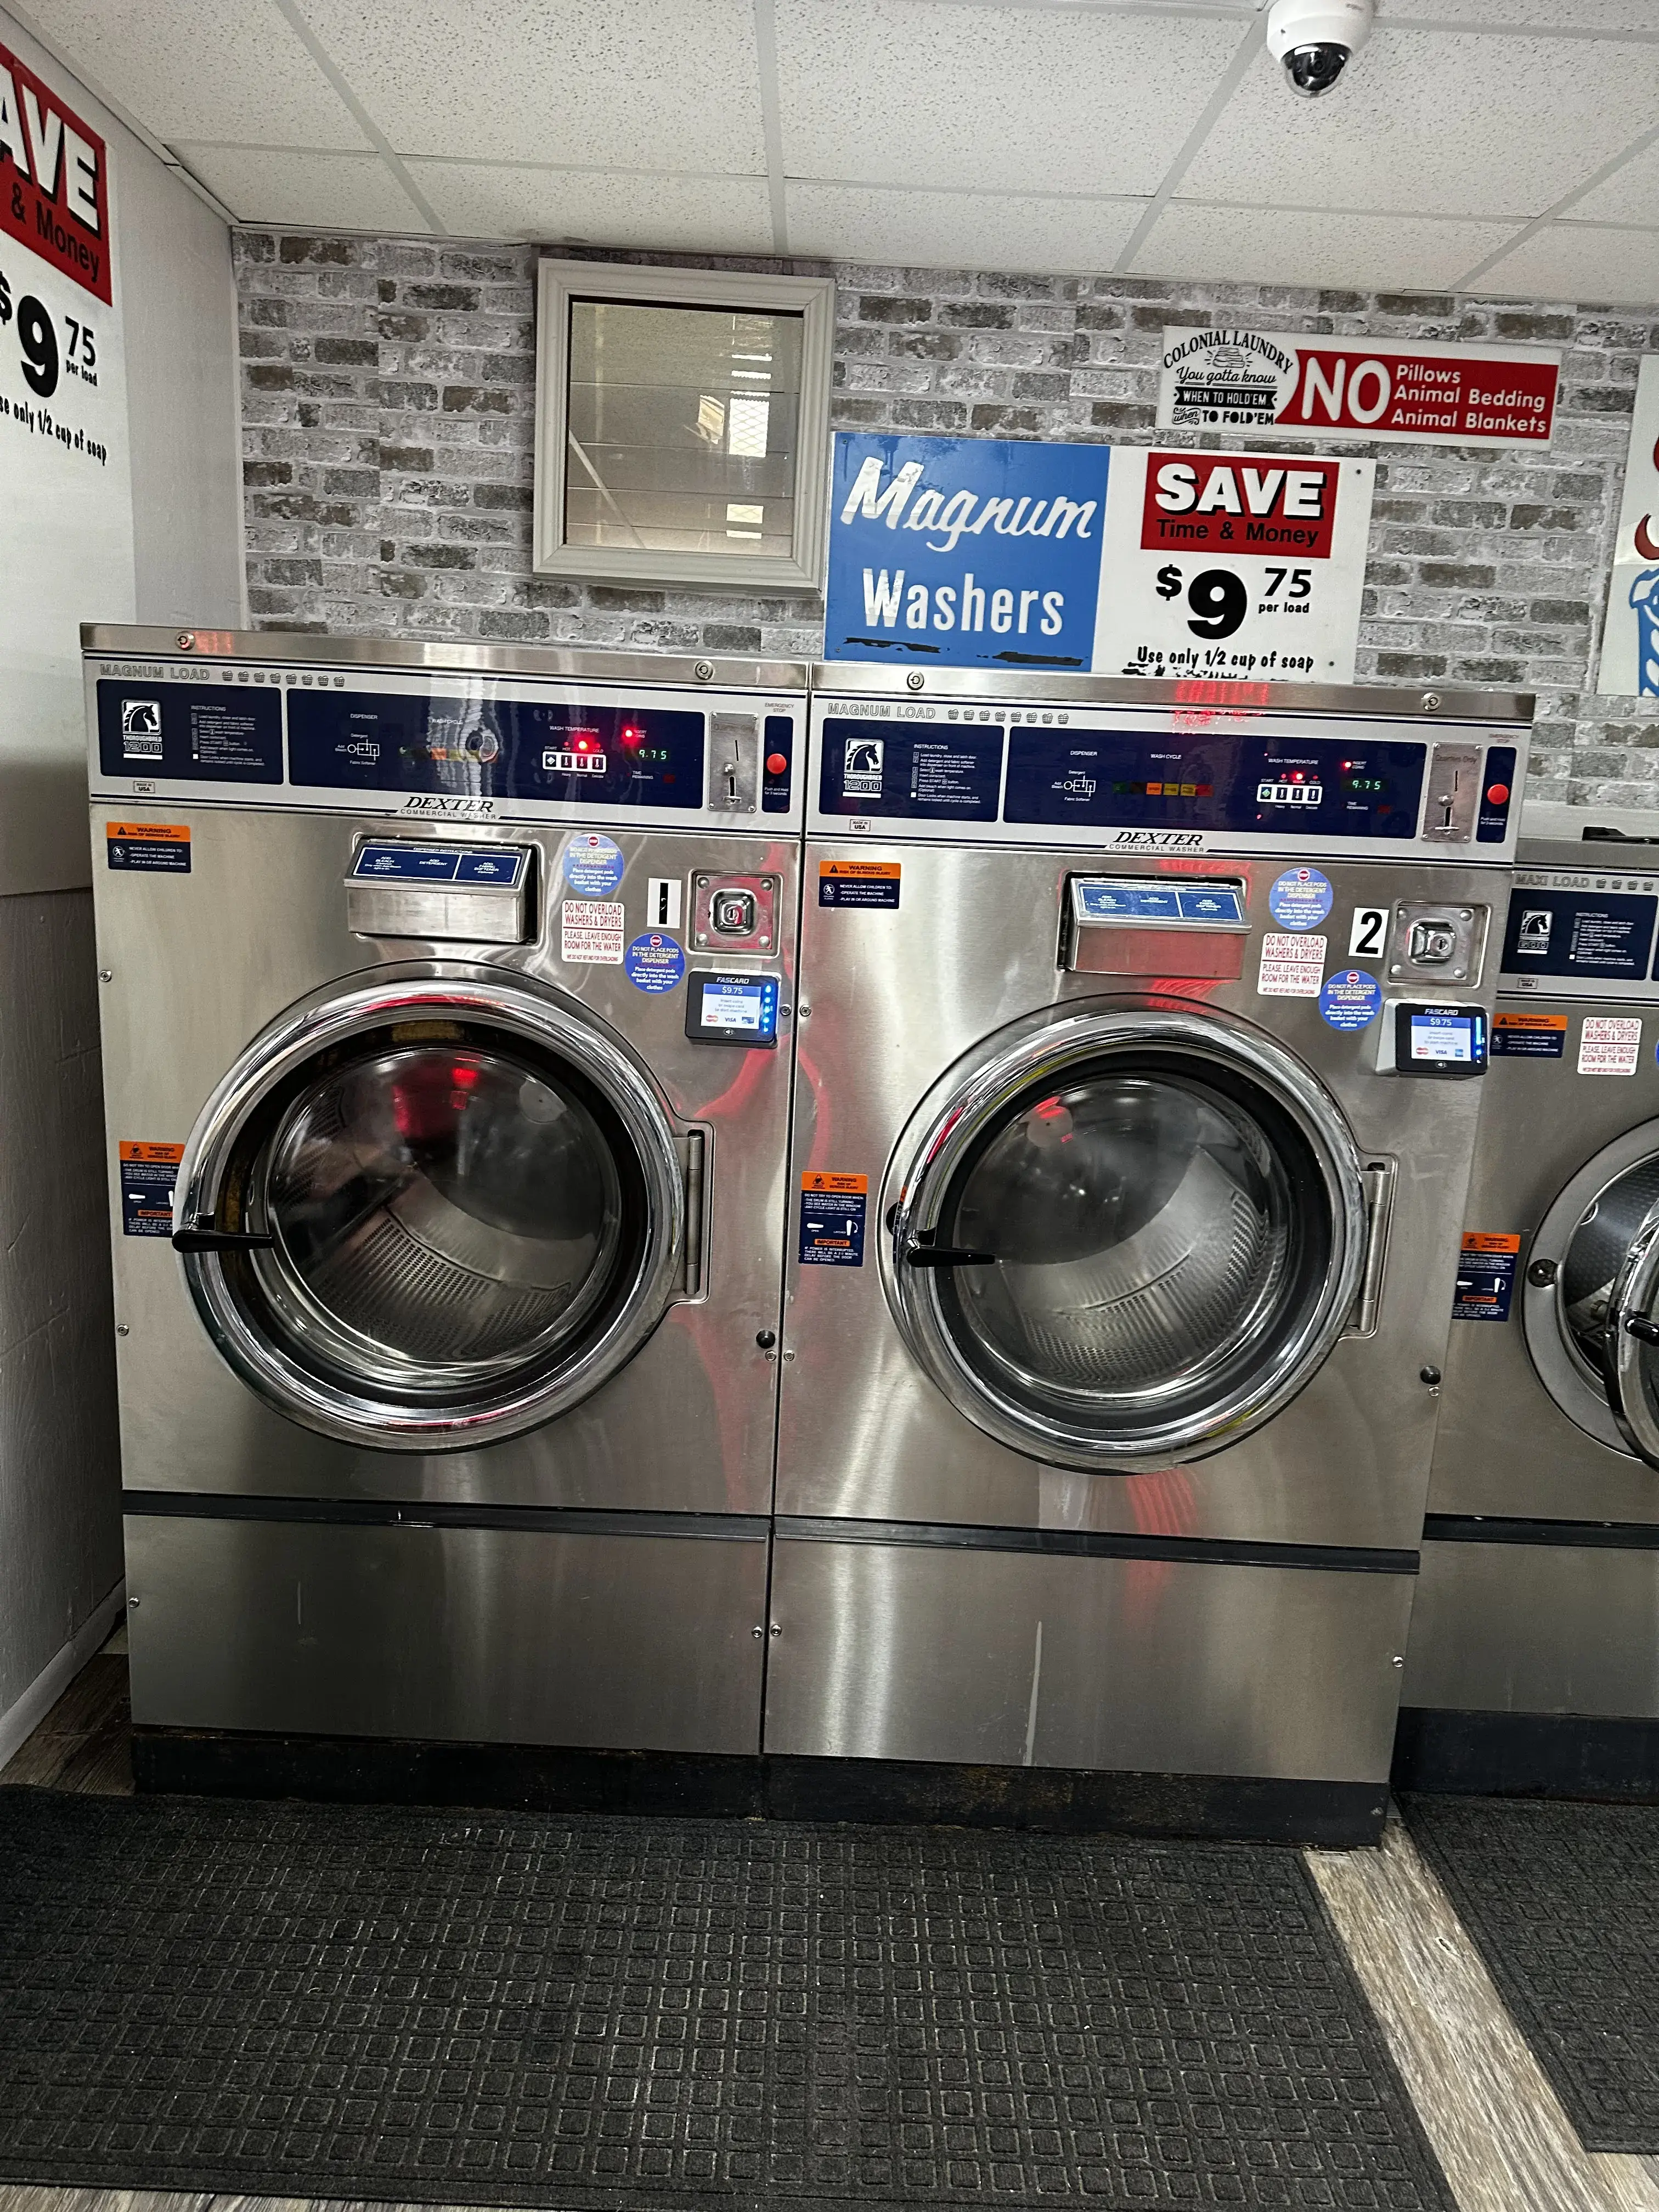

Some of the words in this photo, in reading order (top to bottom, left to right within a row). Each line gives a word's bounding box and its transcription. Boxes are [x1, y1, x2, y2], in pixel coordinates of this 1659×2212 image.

[10, 182, 26, 225] &
[36, 200, 99, 283] Money
[65, 315, 95, 366] 75
[1164, 330, 1230, 369] COLONIAL
[1233, 331, 1293, 375] LAUNDRY
[66, 359, 78, 376] per
[81, 365, 98, 386] load
[1176, 366, 1205, 384] You
[1206, 369, 1240, 386] gotta
[1242, 369, 1277, 383] know
[1396, 364, 1461, 383] Pillows
[1183, 391, 1209, 403] WHEN
[1213, 392, 1224, 403] TO
[1227, 393, 1267, 405] HOLD'EM
[1301, 357, 1391, 424] NO
[1393, 384, 1460, 403] Animal
[1468, 388, 1545, 412] Bedding
[1174, 410, 1199, 421] when
[1203, 410, 1218, 422] TO
[1223, 411, 1274, 425] FOLD'EM
[1391, 409, 1457, 427] Animal
[1465, 413, 1547, 432] Blankets
[14, 402, 34, 433] only
[38, 409, 53, 435] 1/2
[56, 424, 71, 449] cup
[75, 429, 83, 450] of
[87, 440, 107, 466] soap
[1154, 463, 1327, 521] SAVE
[840, 456, 1097, 552] Magnum
[1156, 518, 1209, 539] Time
[1220, 521, 1234, 540] &
[1246, 522, 1319, 548] Money
[1264, 567, 1312, 598] 75
[863, 568, 1065, 635] Washers
[1258, 603, 1279, 614] per
[1284, 602, 1310, 613] load
[1137, 646, 1163, 663] Use
[1169, 648, 1198, 669] only
[1205, 647, 1226, 667] 1/2
[1232, 655, 1256, 670] cup
[1261, 651, 1277, 667] of
[1282, 656, 1313, 673] soap
[100, 664, 163, 678] MAGNUM
[171, 667, 210, 680] LOAD
[828, 703, 890, 717] MAGNUM
[897, 707, 936, 719] LOAD
[123, 742, 162, 753] 1200
[639, 749, 668, 760] 9.75
[1463, 755, 1477, 764] Only
[844, 780, 882, 791] 1200
[1352, 780, 1381, 790] 9.75
[404, 796, 494, 812] DEXTER
[400, 809, 457, 817] COMMERCIAL
[460, 811, 496, 820] WASHER
[1113, 831, 1203, 846] DEXTER
[1553, 876, 1590, 888] LOAD
[565, 902, 574, 913] DO
[575, 902, 587, 913] NOT
[589, 903, 622, 915] OVERLOAD
[565, 914, 592, 926] WASHERS
[595, 916, 598, 926] &
[600, 916, 621, 927] DRYERS
[601, 933, 621, 941] ENOUGH
[1355, 911, 1382, 955] 2
[565, 940, 580, 949] ROOM
[582, 941, 591, 950] FOR
[592, 942, 602, 950] THE
[603, 943, 621, 951] WATER
[1266, 935, 1276, 945] DO
[1277, 936, 1290, 946] NOT
[1291, 936, 1324, 948] OVERLOAD
[1266, 947, 1293, 958] WASHERS
[1295, 949, 1298, 959] &
[1301, 949, 1323, 960] DRYERS
[1283, 965, 1299, 973] LEAVE
[1300, 966, 1321, 974] ENOUGH
[1262, 973, 1277, 982] ROOM
[1279, 974, 1289, 983] FOR
[1290, 975, 1300, 983] THE
[1301, 975, 1319, 984] WATER
[722, 986, 743, 994] $9.75
